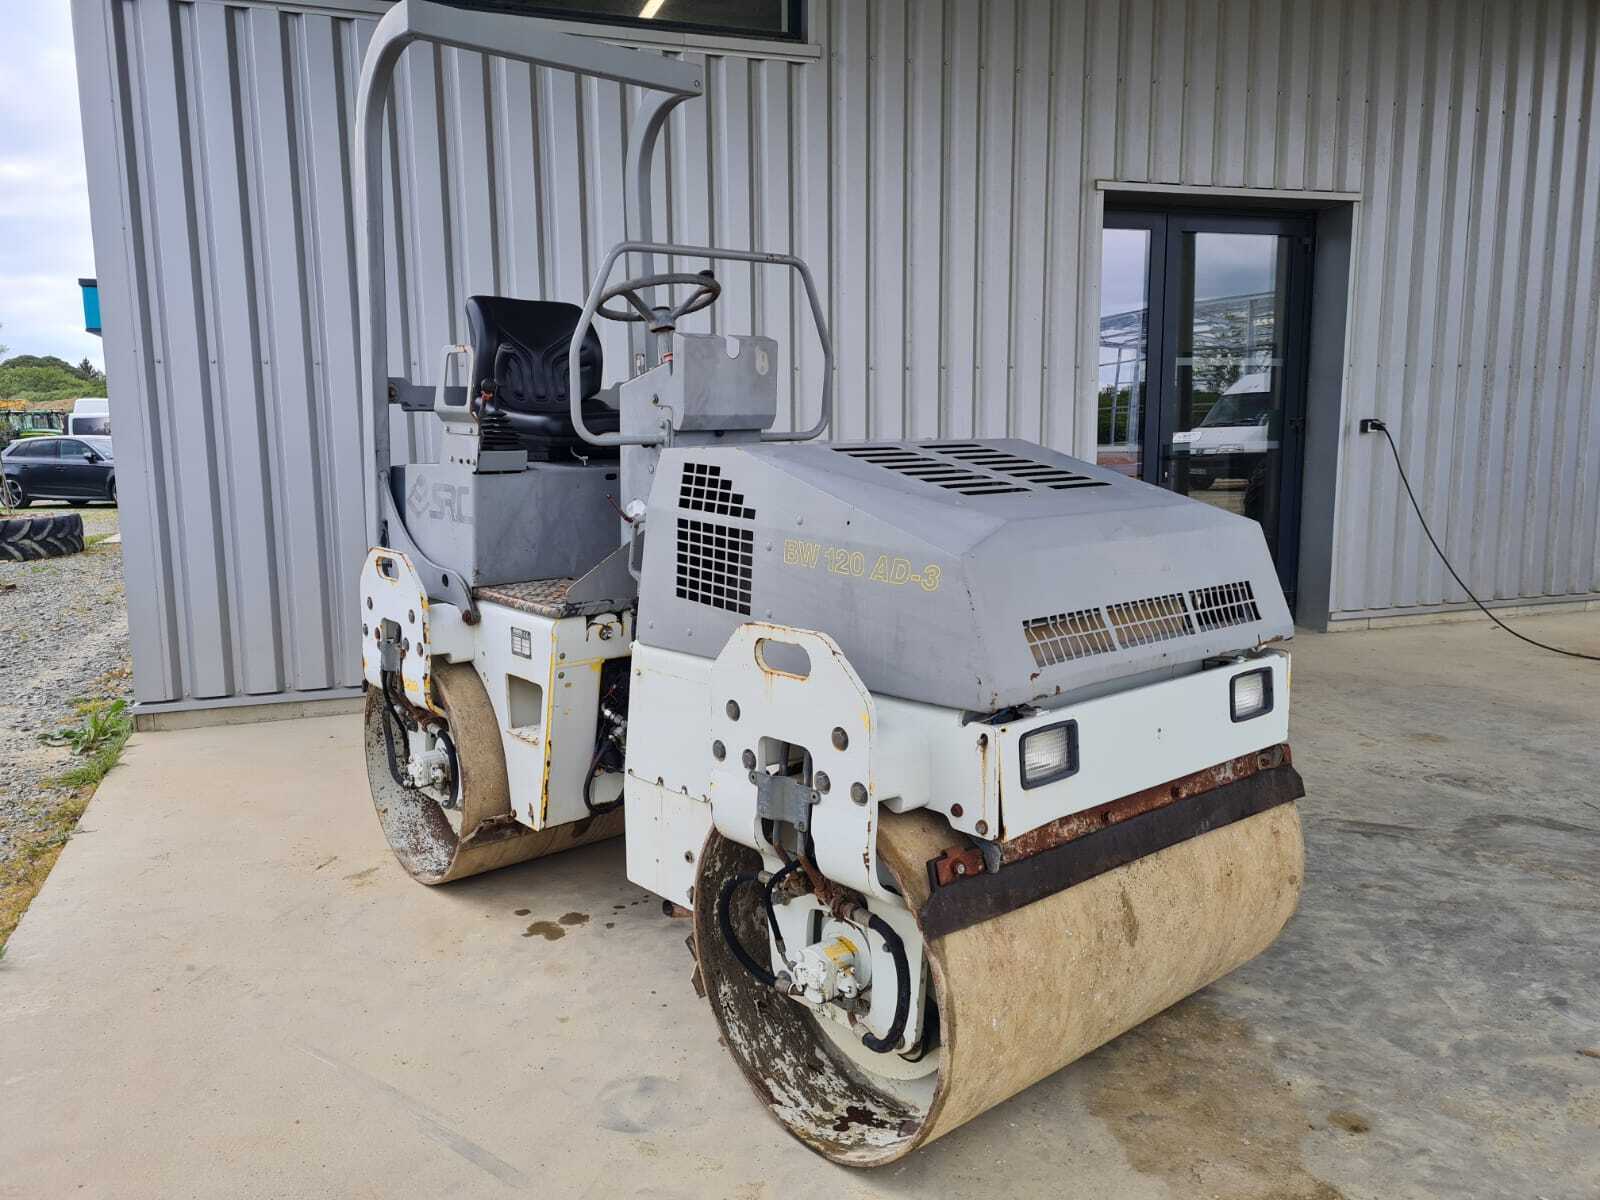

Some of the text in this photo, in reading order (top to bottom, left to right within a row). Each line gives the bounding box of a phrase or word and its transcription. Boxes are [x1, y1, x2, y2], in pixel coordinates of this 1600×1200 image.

[783, 538, 942, 592] BW 120 AD-3
